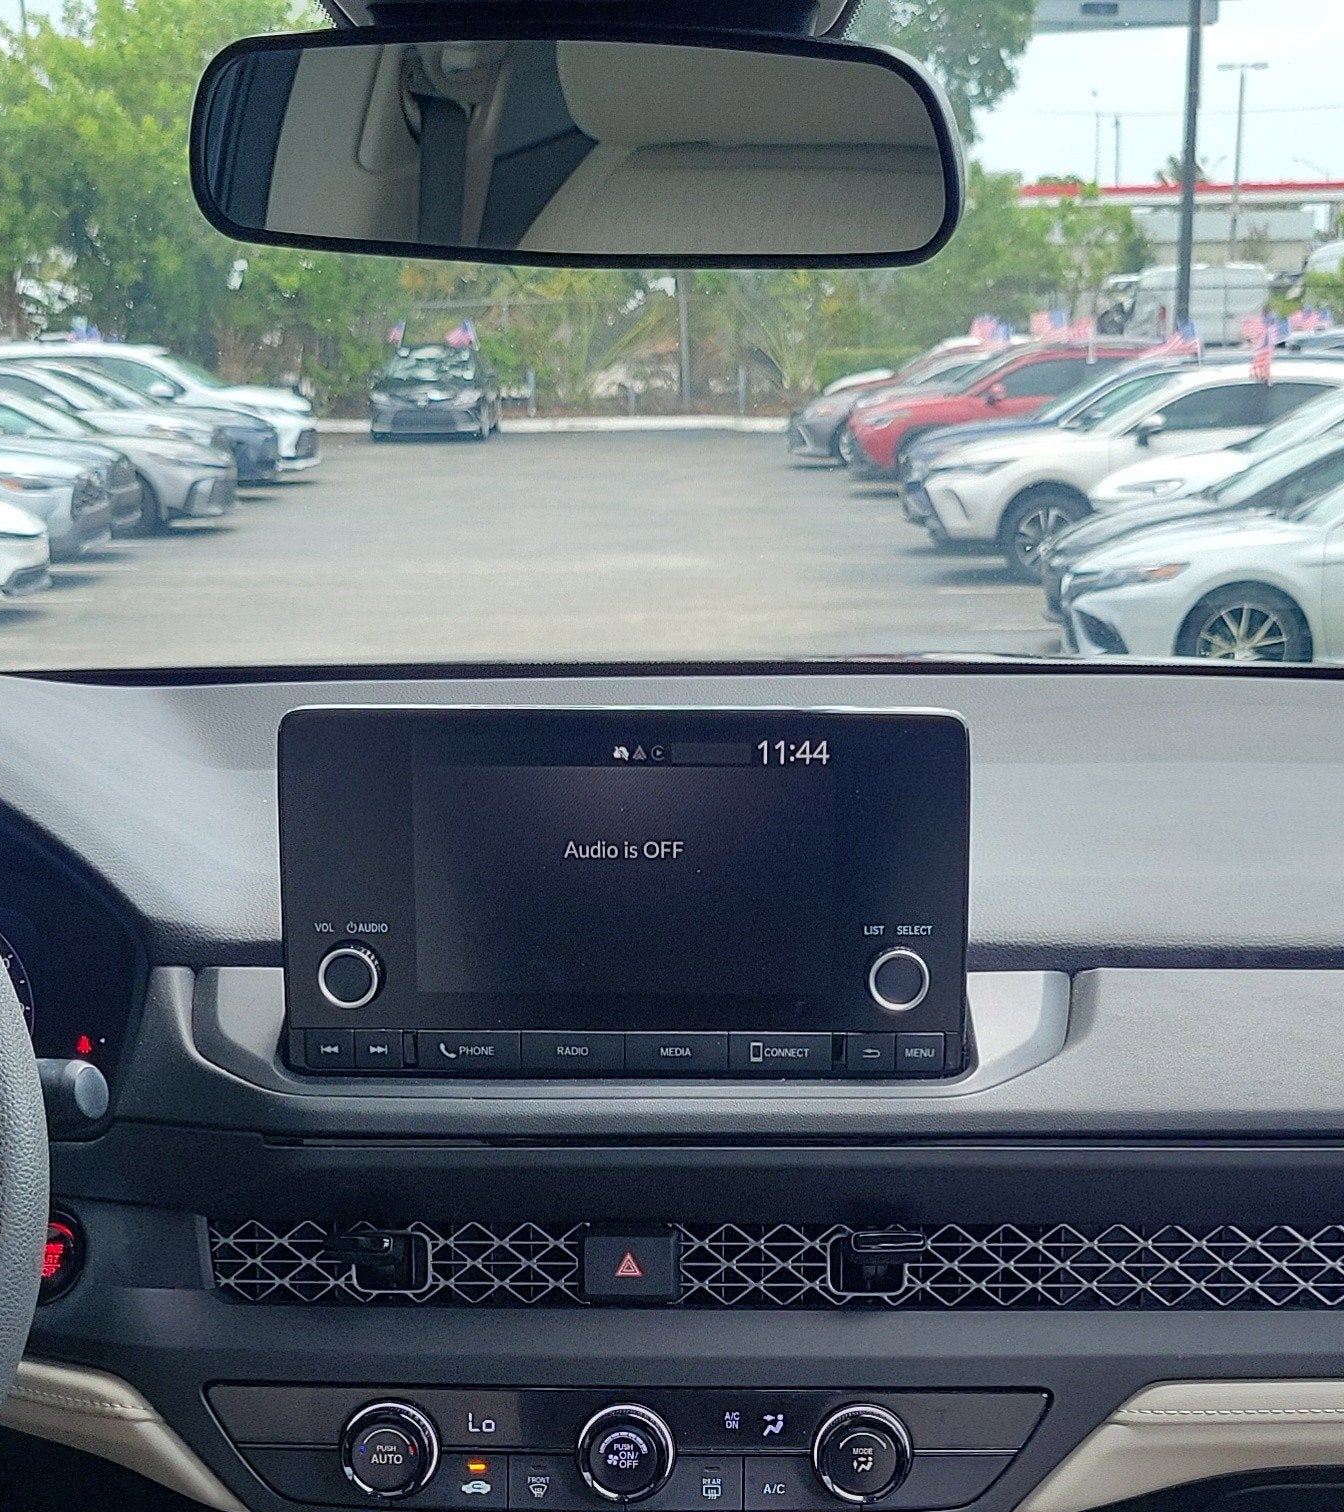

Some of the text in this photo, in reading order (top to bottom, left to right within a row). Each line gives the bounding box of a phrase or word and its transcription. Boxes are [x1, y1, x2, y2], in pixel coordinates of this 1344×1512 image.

[757, 740, 830, 765] 11:44
[564, 841, 684, 859] Audio is OFF
[314, 922, 334, 933] VOL
[358, 922, 389, 933] AUDIO
[863, 925, 885, 935] LIST
[896, 925, 933, 935] SELECT
[459, 1046, 494, 1056] PHONE
[557, 1046, 589, 1056] RADIO
[660, 1047, 691, 1057] MEDIA
[764, 1047, 809, 1058] CONNECT
[905, 1048, 935, 1058] MENU
[724, 1411, 740, 1421] A/C
[468, 1412, 496, 1433] Lo
[725, 1421, 739, 1430] ON
[619, 1451, 639, 1460] ON/
[852, 1447, 873, 1455] MODE
[370, 1454, 404, 1465] AUTO
[619, 1460, 639, 1469] OFF
[527, 1476, 550, 1484] FRONT
[702, 1478, 722, 1486] REAR
[763, 1483, 786, 1494] A/C
